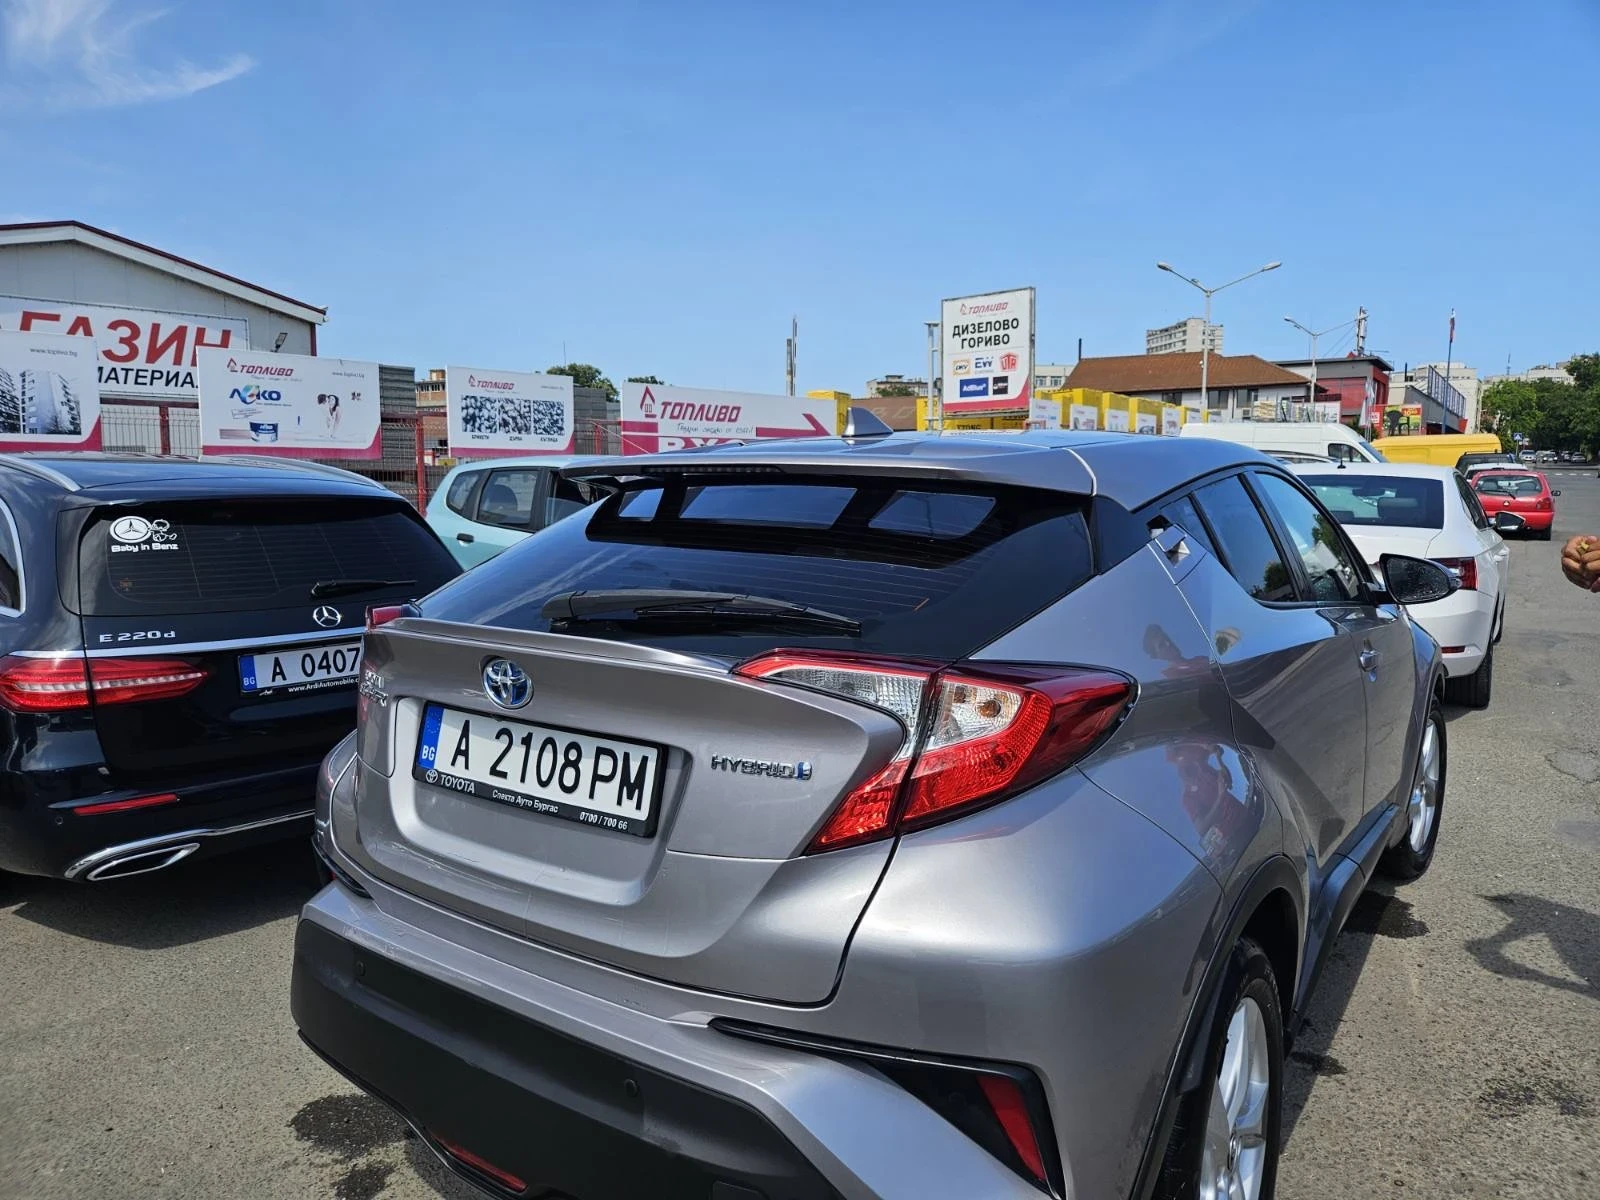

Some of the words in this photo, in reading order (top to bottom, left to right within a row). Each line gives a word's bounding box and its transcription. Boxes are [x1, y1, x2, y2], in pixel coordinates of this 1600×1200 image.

[969, 302, 1008, 314] ТОПЛИВО
[952, 318, 1020, 339] ДИЗЕЛОВО
[961, 334, 1010, 349] ГОРИВО
[240, 364, 295, 377] ТОПЛИВО
[476, 380, 515, 390] ТОПЛИВО
[660, 401, 742, 423] ТОПЛИВО
[99, 634, 113, 642] E
[271, 657, 287, 683] A
[301, 647, 360, 678] 0407
[243, 677, 256, 686] BG
[421, 745, 436, 760] BG
[450, 719, 471, 770] A
[489, 727, 583, 794] 2108
[588, 746, 649, 811] PM
[711, 754, 795, 779] HYBRID
[440, 774, 475, 794] TOYOTA
[515, 795, 533, 807] Ауто
[533, 799, 559, 813] Бургас
[579, 811, 598, 824] 0700
[603, 816, 617, 828] 700
[617, 820, 628, 830] 66
